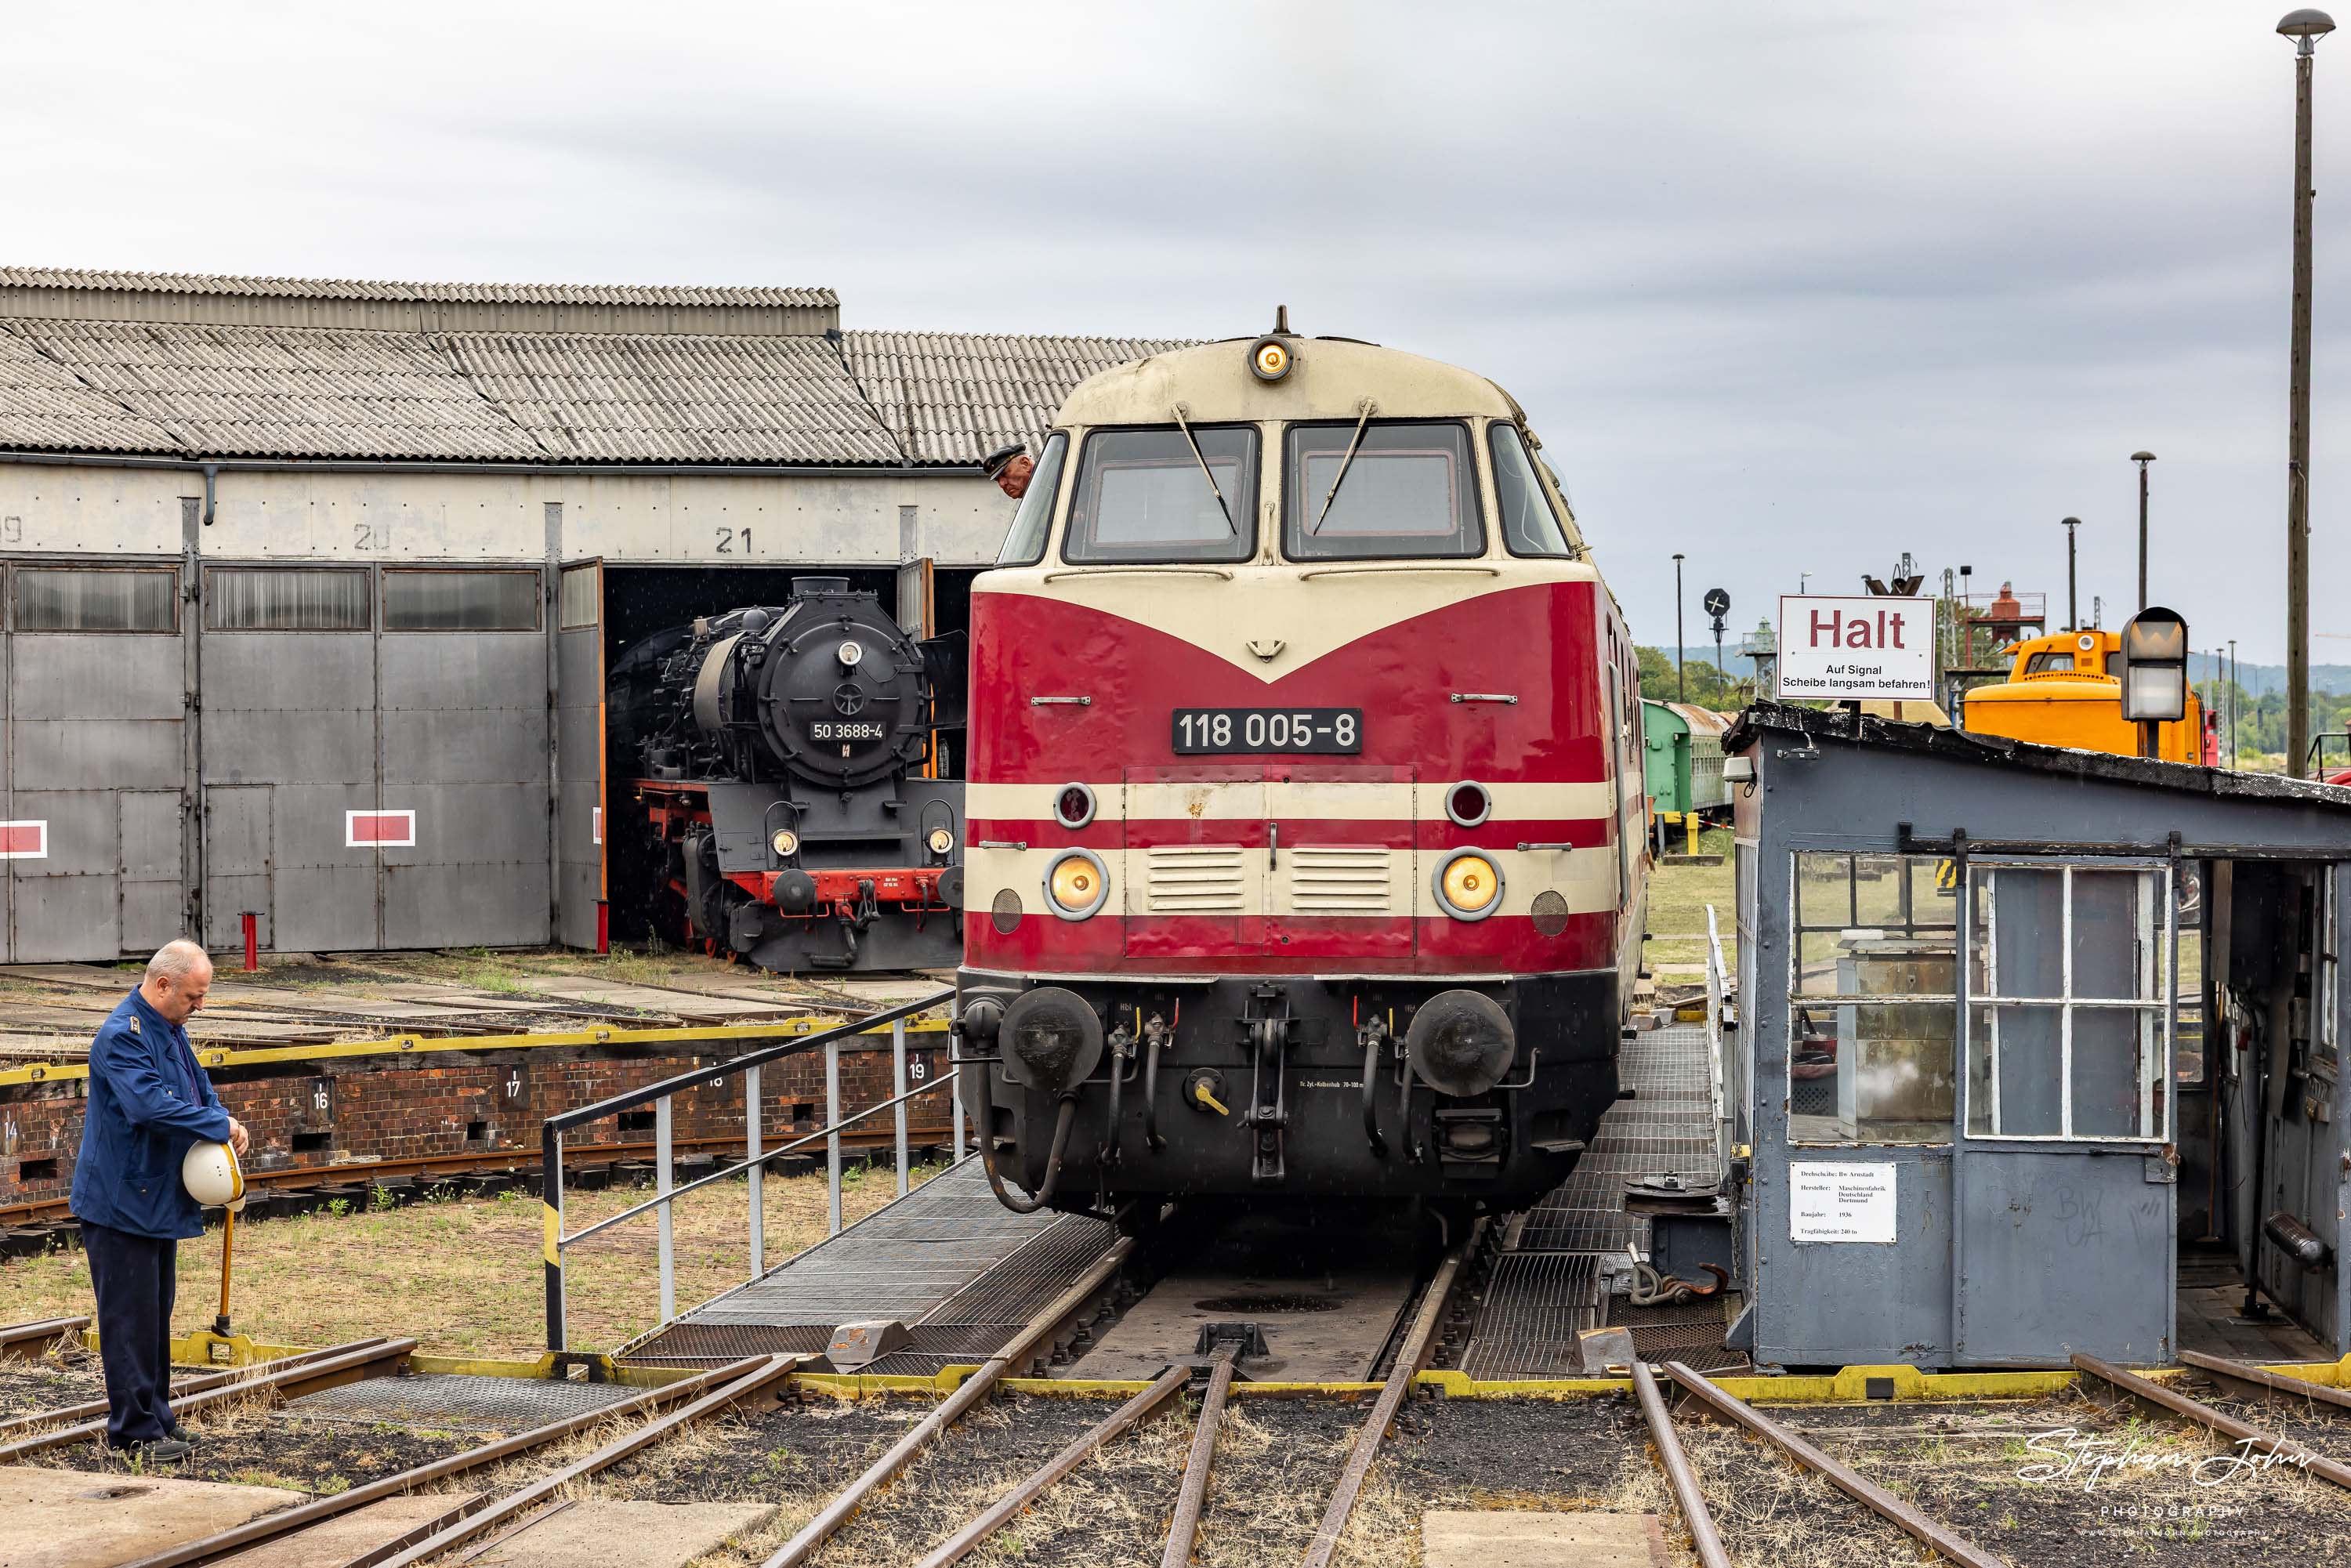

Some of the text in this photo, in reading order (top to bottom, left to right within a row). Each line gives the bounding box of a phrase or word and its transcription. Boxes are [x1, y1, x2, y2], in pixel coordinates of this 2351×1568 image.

[715, 527, 752, 553] 21
[1809, 609, 1905, 650] Halt
[1826, 664, 1882, 676] Auf Signal
[1783, 677, 1930, 690] Scheibe langsam befahren!
[814, 724, 883, 738] 50 3688-4
[1179, 713, 1356, 747] 118 005-8
[909, 1063, 925, 1079] 19
[505, 1081, 521, 1098] 17
[313, 1092, 328, 1110] 16
[4, 1121, 18, 1139] 14
